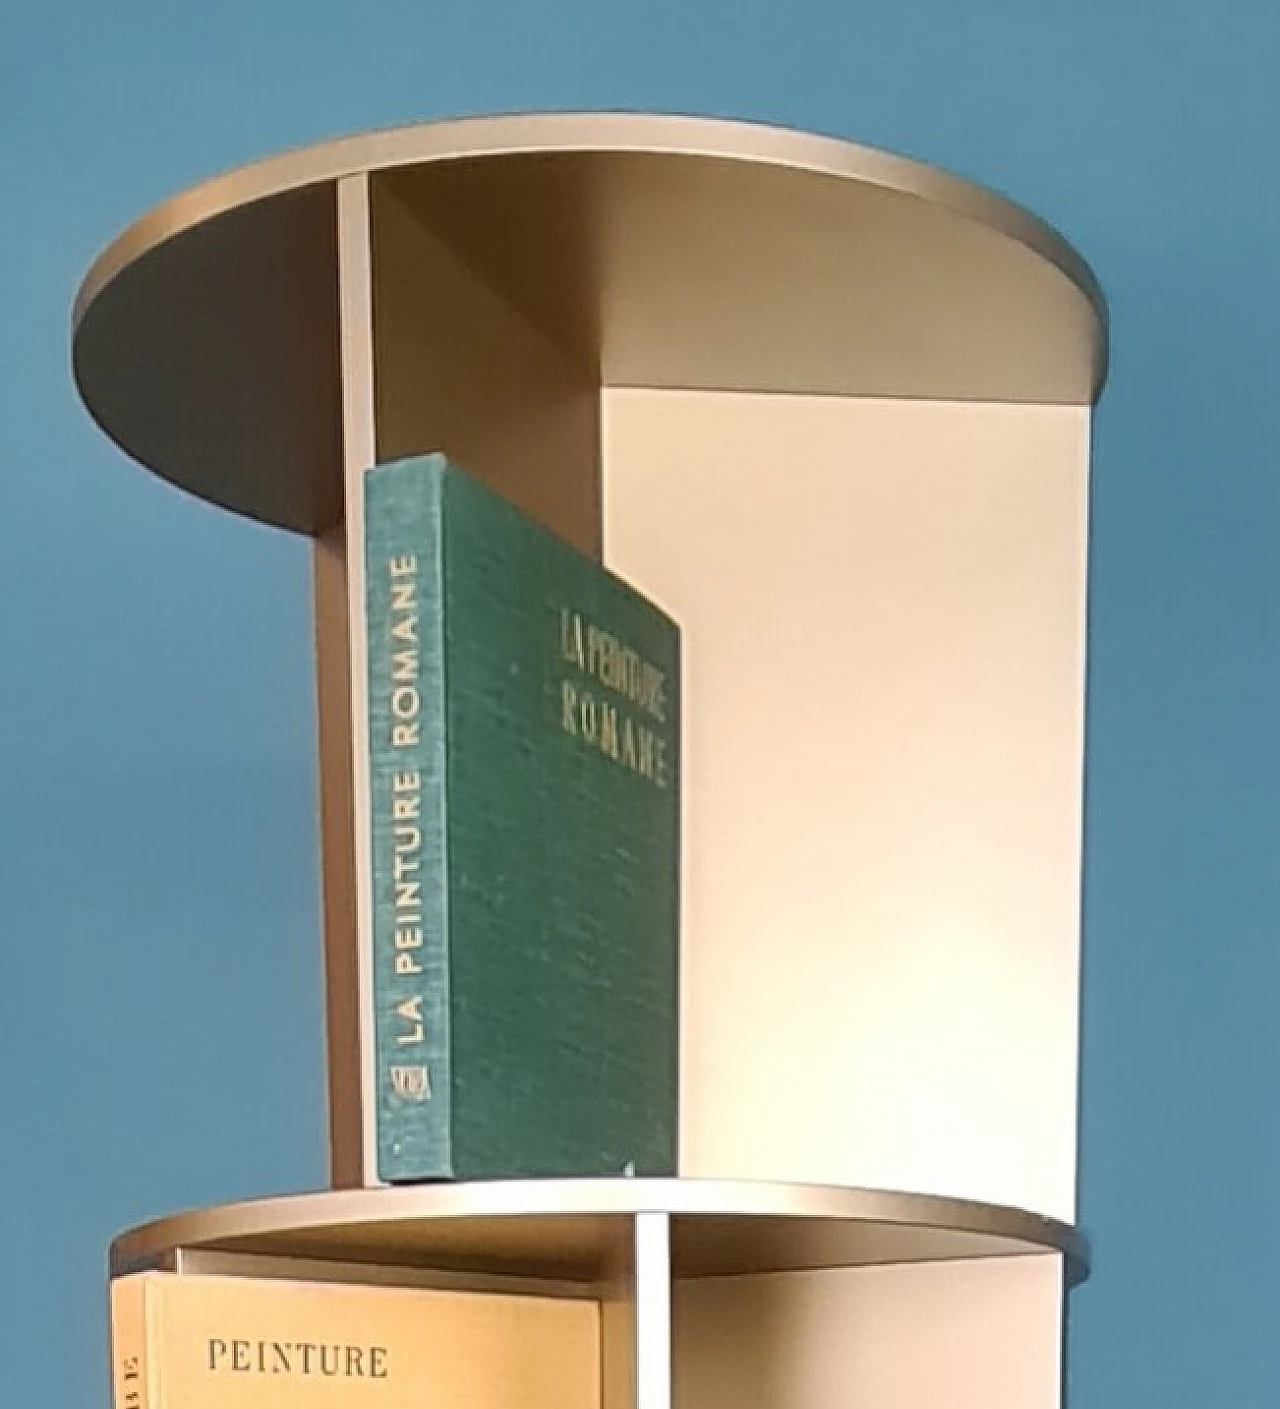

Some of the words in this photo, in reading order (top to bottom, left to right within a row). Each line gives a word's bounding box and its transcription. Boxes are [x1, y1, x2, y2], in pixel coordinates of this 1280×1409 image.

[389, 553, 421, 748] ROMANE
[561, 607, 585, 673] LA
[587, 623, 667, 724] PEINTURE
[561, 679, 668, 788] ROMANE
[392, 770, 424, 975] PEINTURE
[395, 994, 425, 1045] LA
[207, 1337, 390, 1379] PEINTURE
